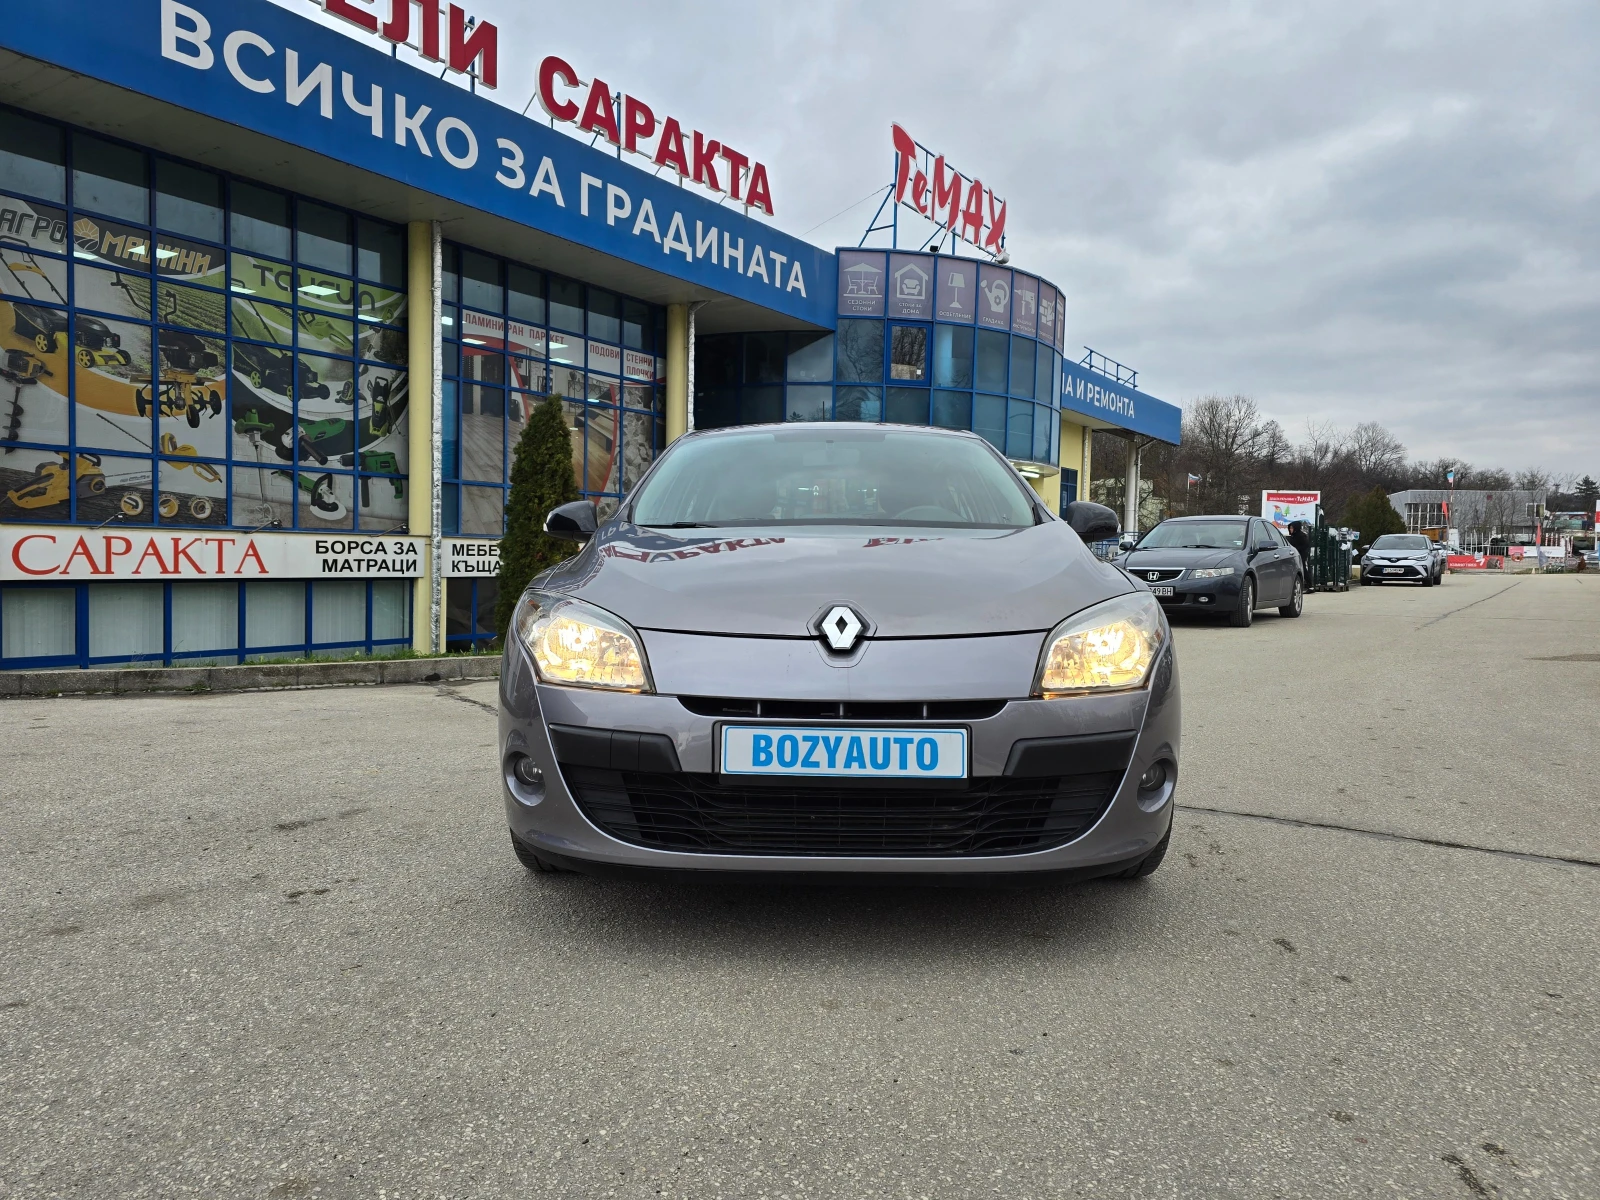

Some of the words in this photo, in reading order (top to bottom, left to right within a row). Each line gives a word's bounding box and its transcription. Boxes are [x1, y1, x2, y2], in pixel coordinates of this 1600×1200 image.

[161, 0, 479, 170] ВСИЧКО
[495, 138, 565, 208] ЗА
[580, 171, 807, 298] ГРАДИНАТА
[535, 55, 774, 217] САРАКТА
[0, 208, 68, 244] АГРО
[100, 231, 211, 276] МАШИНИ
[465, 313, 524, 337] ЛАМИНИРАН
[529, 328, 565, 345] ПАРКЕТ
[589, 343, 620, 360] ПОДОВИ
[626, 352, 653, 368] СТЕННИ
[626, 366, 655, 380] ПЛОЧКИ
[1076, 377, 1085, 400] И
[1086, 382, 1136, 419] РЕМОНТА
[11, 534, 270, 576] САРАКТА
[315, 540, 388, 555] БОРСА
[393, 542, 418, 555] ЗА
[322, 558, 418, 575] МАТРАЦИ
[752, 734, 939, 771] BOZYAUTO
